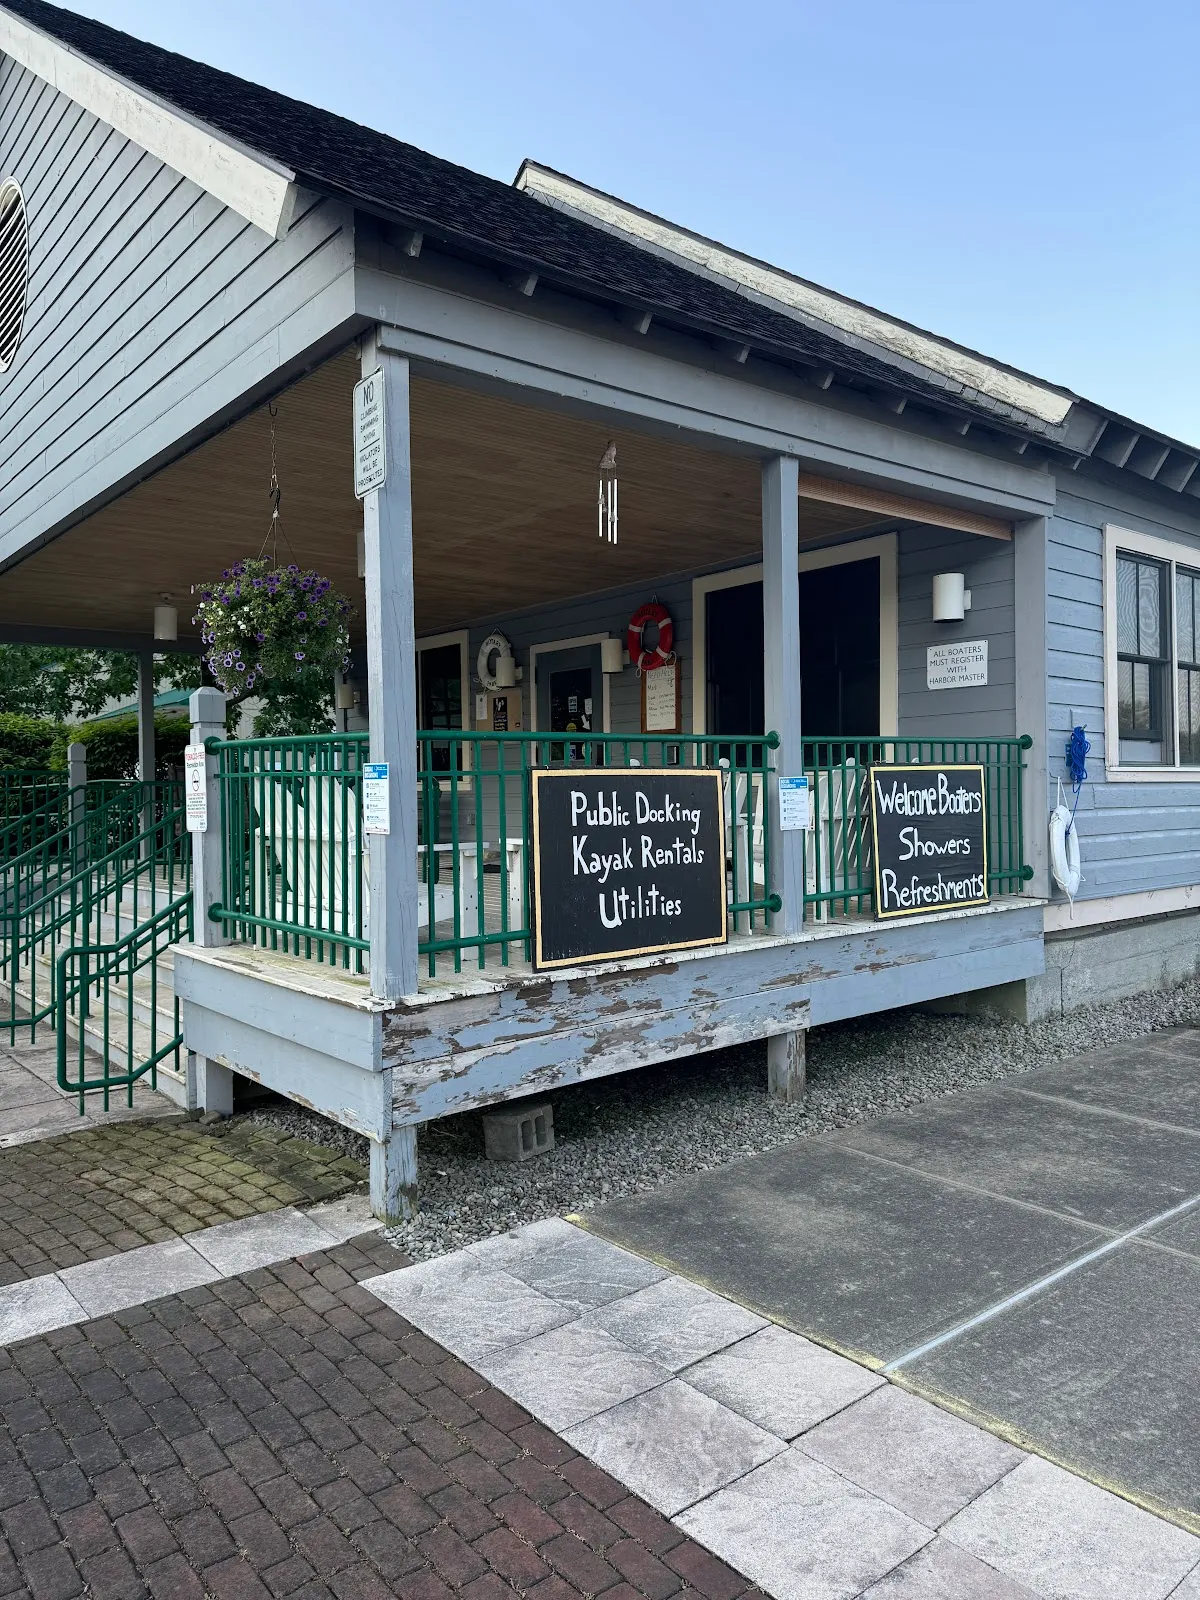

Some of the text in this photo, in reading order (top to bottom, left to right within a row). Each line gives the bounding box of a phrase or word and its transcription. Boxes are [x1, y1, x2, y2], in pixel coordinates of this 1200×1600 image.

[363, 381, 374, 407] NO
[360, 447, 381, 463] VIOLATORS
[362, 458, 378, 475] WILL BE
[929, 655, 985, 667] MUST REGISTER
[948, 645, 982, 656] BOATERS
[929, 673, 986, 685] HARBOR MASTER
[876, 773, 982, 816] Welcome Boaters
[570, 790, 701, 835] Public Docking
[899, 826, 971, 861] Showers
[572, 834, 705, 884] Kayak Rentals
[881, 868, 984, 909] Refreshments
[599, 883, 682, 929] Utilities
